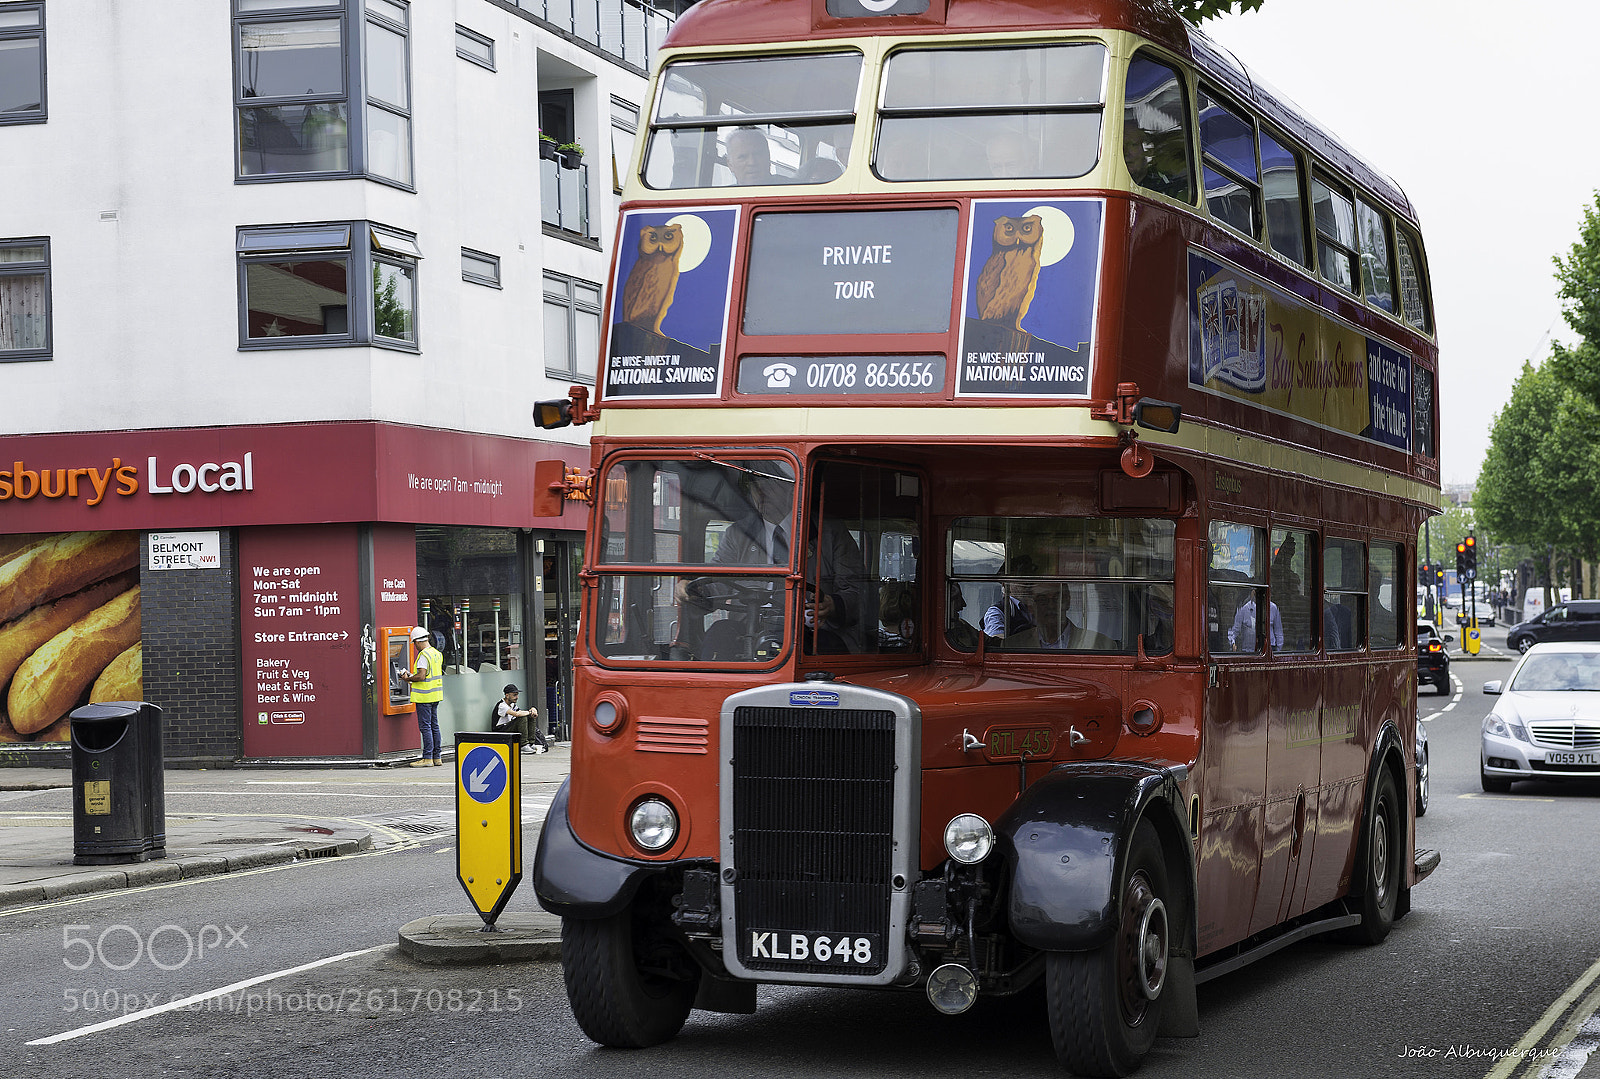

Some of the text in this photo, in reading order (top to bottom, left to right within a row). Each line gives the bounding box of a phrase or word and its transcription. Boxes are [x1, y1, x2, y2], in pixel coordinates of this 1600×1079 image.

[823, 245, 892, 265] PRIVATE
[834, 280, 875, 299] TOUR
[611, 356, 621, 367] BE
[671, 354, 680, 366] IN
[967, 352, 978, 364] BE
[1035, 352, 1045, 364] IN
[1269, 322, 1364, 412] Buy Savings Stamps
[1368, 347, 1407, 393] and save for
[609, 367, 716, 385] NATIONAL SAVINGS
[806, 363, 933, 388] 01708 865656
[966, 365, 1084, 382] NATIONAL SAVINGS
[1373, 393, 1407, 438] the future
[148, 452, 253, 494] Local
[407, 473, 419, 489] We
[420, 477, 432, 490] are
[434, 478, 452, 494] open
[453, 477, 468, 492] 7am
[474, 479, 503, 498] midnight
[153, 543, 203, 553] BELMONT
[153, 554, 192, 564] STREET
[253, 566, 320, 577] We are open
[253, 579, 300, 590] Mon-Sat
[383, 578, 406, 588] Free Cash
[254, 593, 278, 603] 7am
[289, 591, 338, 604] midnight
[380, 591, 409, 602] Withdrawals
[254, 607, 275, 617] Sun
[278, 606, 303, 616] 7am
[314, 605, 341, 617] 11pm
[254, 631, 339, 643] Store Entrance
[256, 658, 290, 669] Bakery
[257, 669, 310, 680] Fruit & Veg
[257, 680, 313, 691] Meat & Fish
[257, 692, 316, 703] Beer & Wine
[1286, 704, 1360, 750] LONDON RANSPORT
[1549, 753, 1597, 763] VO59 XTL
